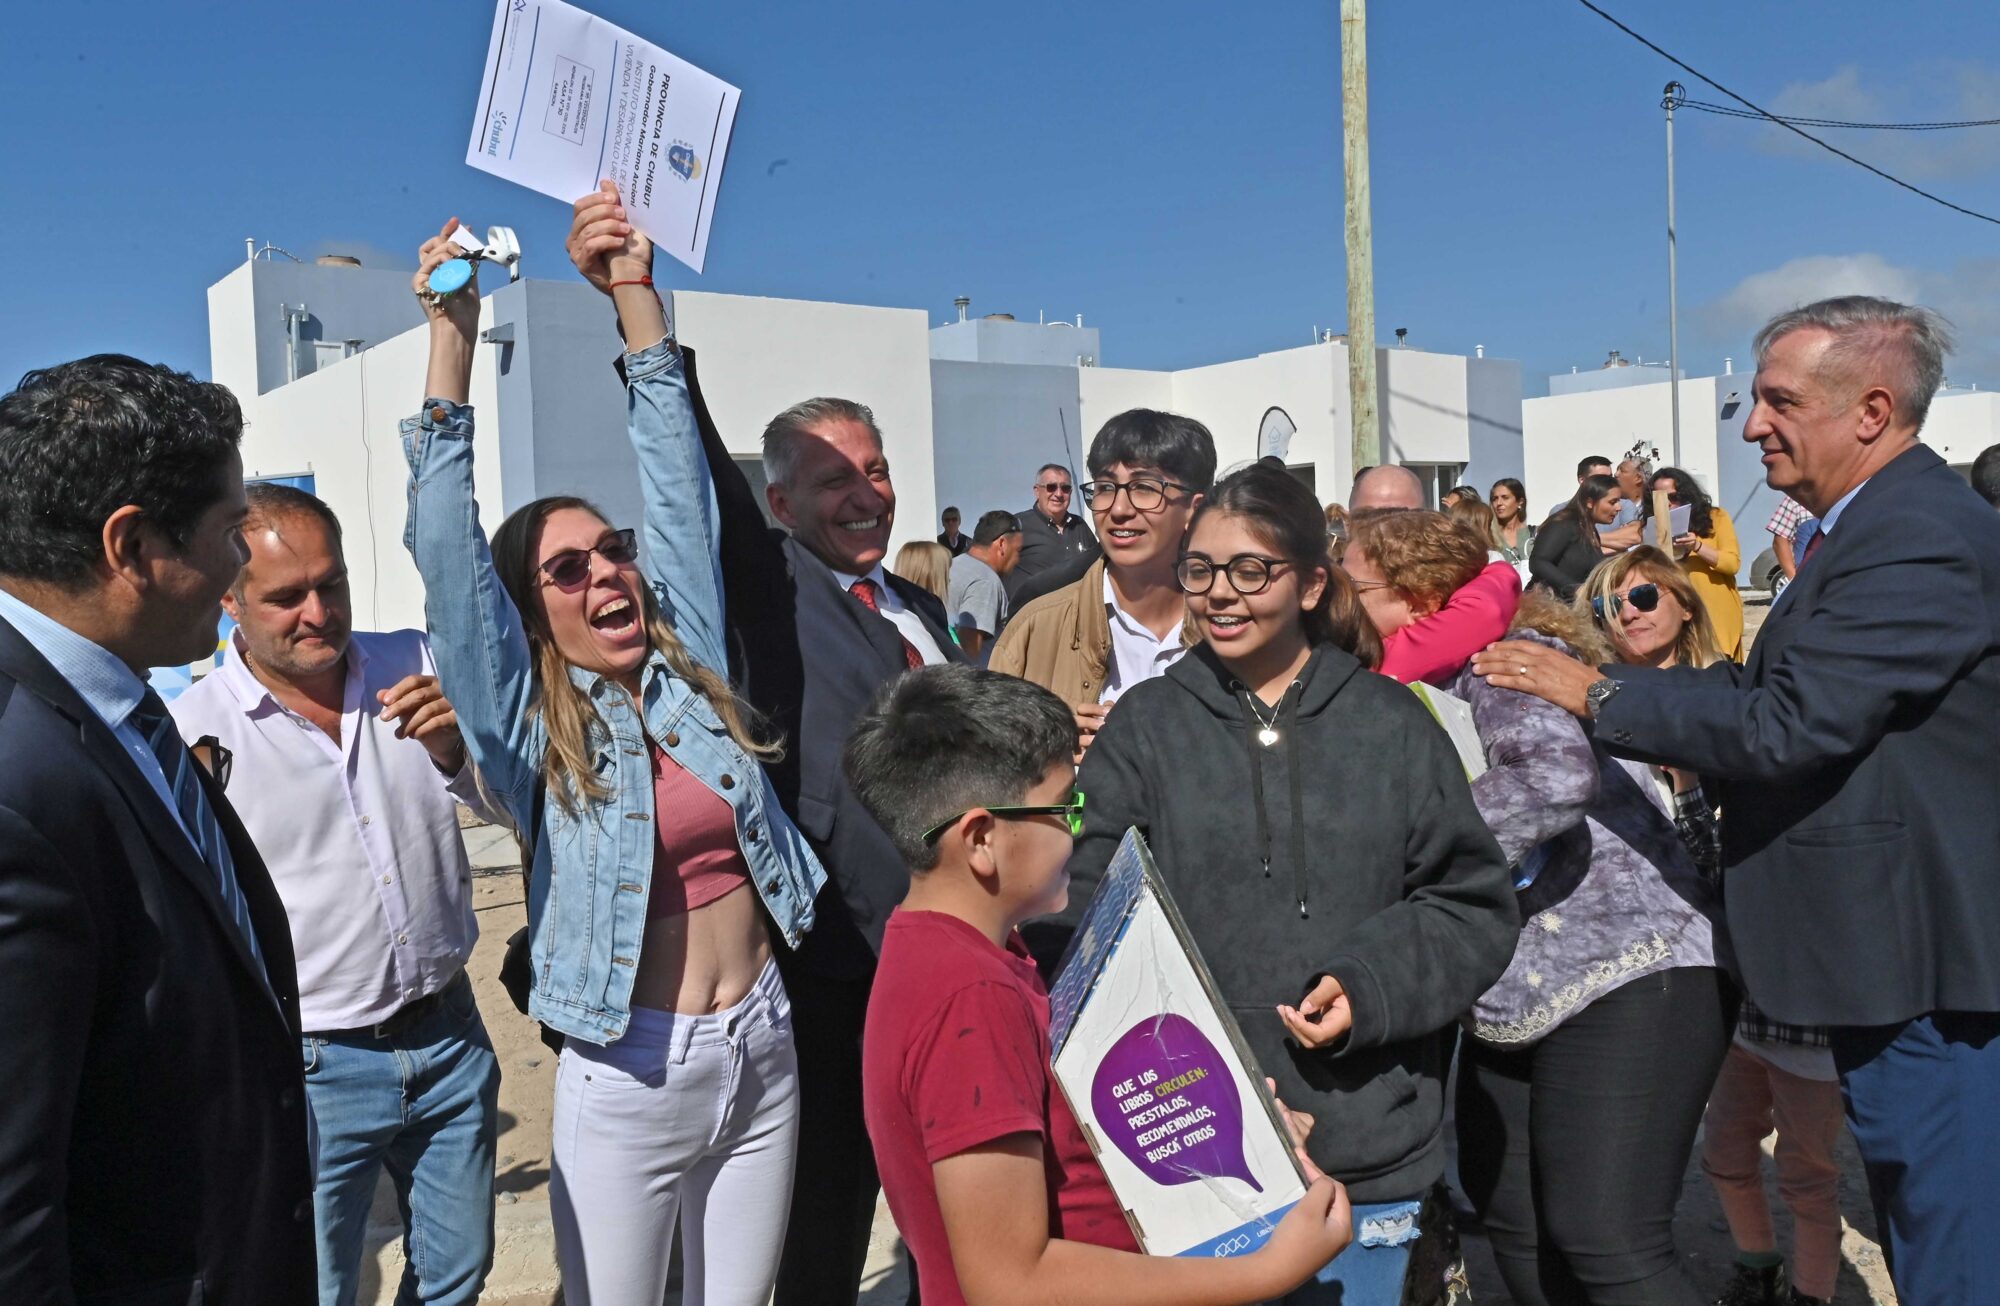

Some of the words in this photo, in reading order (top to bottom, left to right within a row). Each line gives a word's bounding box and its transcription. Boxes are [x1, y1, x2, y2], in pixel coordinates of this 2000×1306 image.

[622, 43, 634, 87] VIVIENDA
[630, 59, 643, 110] INSTITUTO
[621, 89, 627, 98] Y
[641, 64, 656, 128] Gobernador
[653, 72, 670, 141] PROVINCIA
[612, 98, 626, 160] DESARROLLO
[621, 110, 634, 167] PROVINCIAL
[634, 128, 646, 172] Mariano
[649, 141, 657, 158] DE
[618, 182, 625, 194] LA
[619, 167, 627, 182] DE
[629, 171, 639, 208] Arcioni
[642, 159, 656, 208] CHUBUT
[1112, 1079, 1136, 1098] QUE
[1138, 1069, 1158, 1086] LOS
[1119, 1091, 1153, 1114] LIBROS
[1155, 1067, 1208, 1097] CIRCULEN:
[1128, 1096, 1191, 1130] PRESTALOS,
[1137, 1106, 1216, 1147] RECOMENDALOS,
[1146, 1137, 1182, 1163] BUSCÁ
[1183, 1125, 1216, 1147] OTROS
